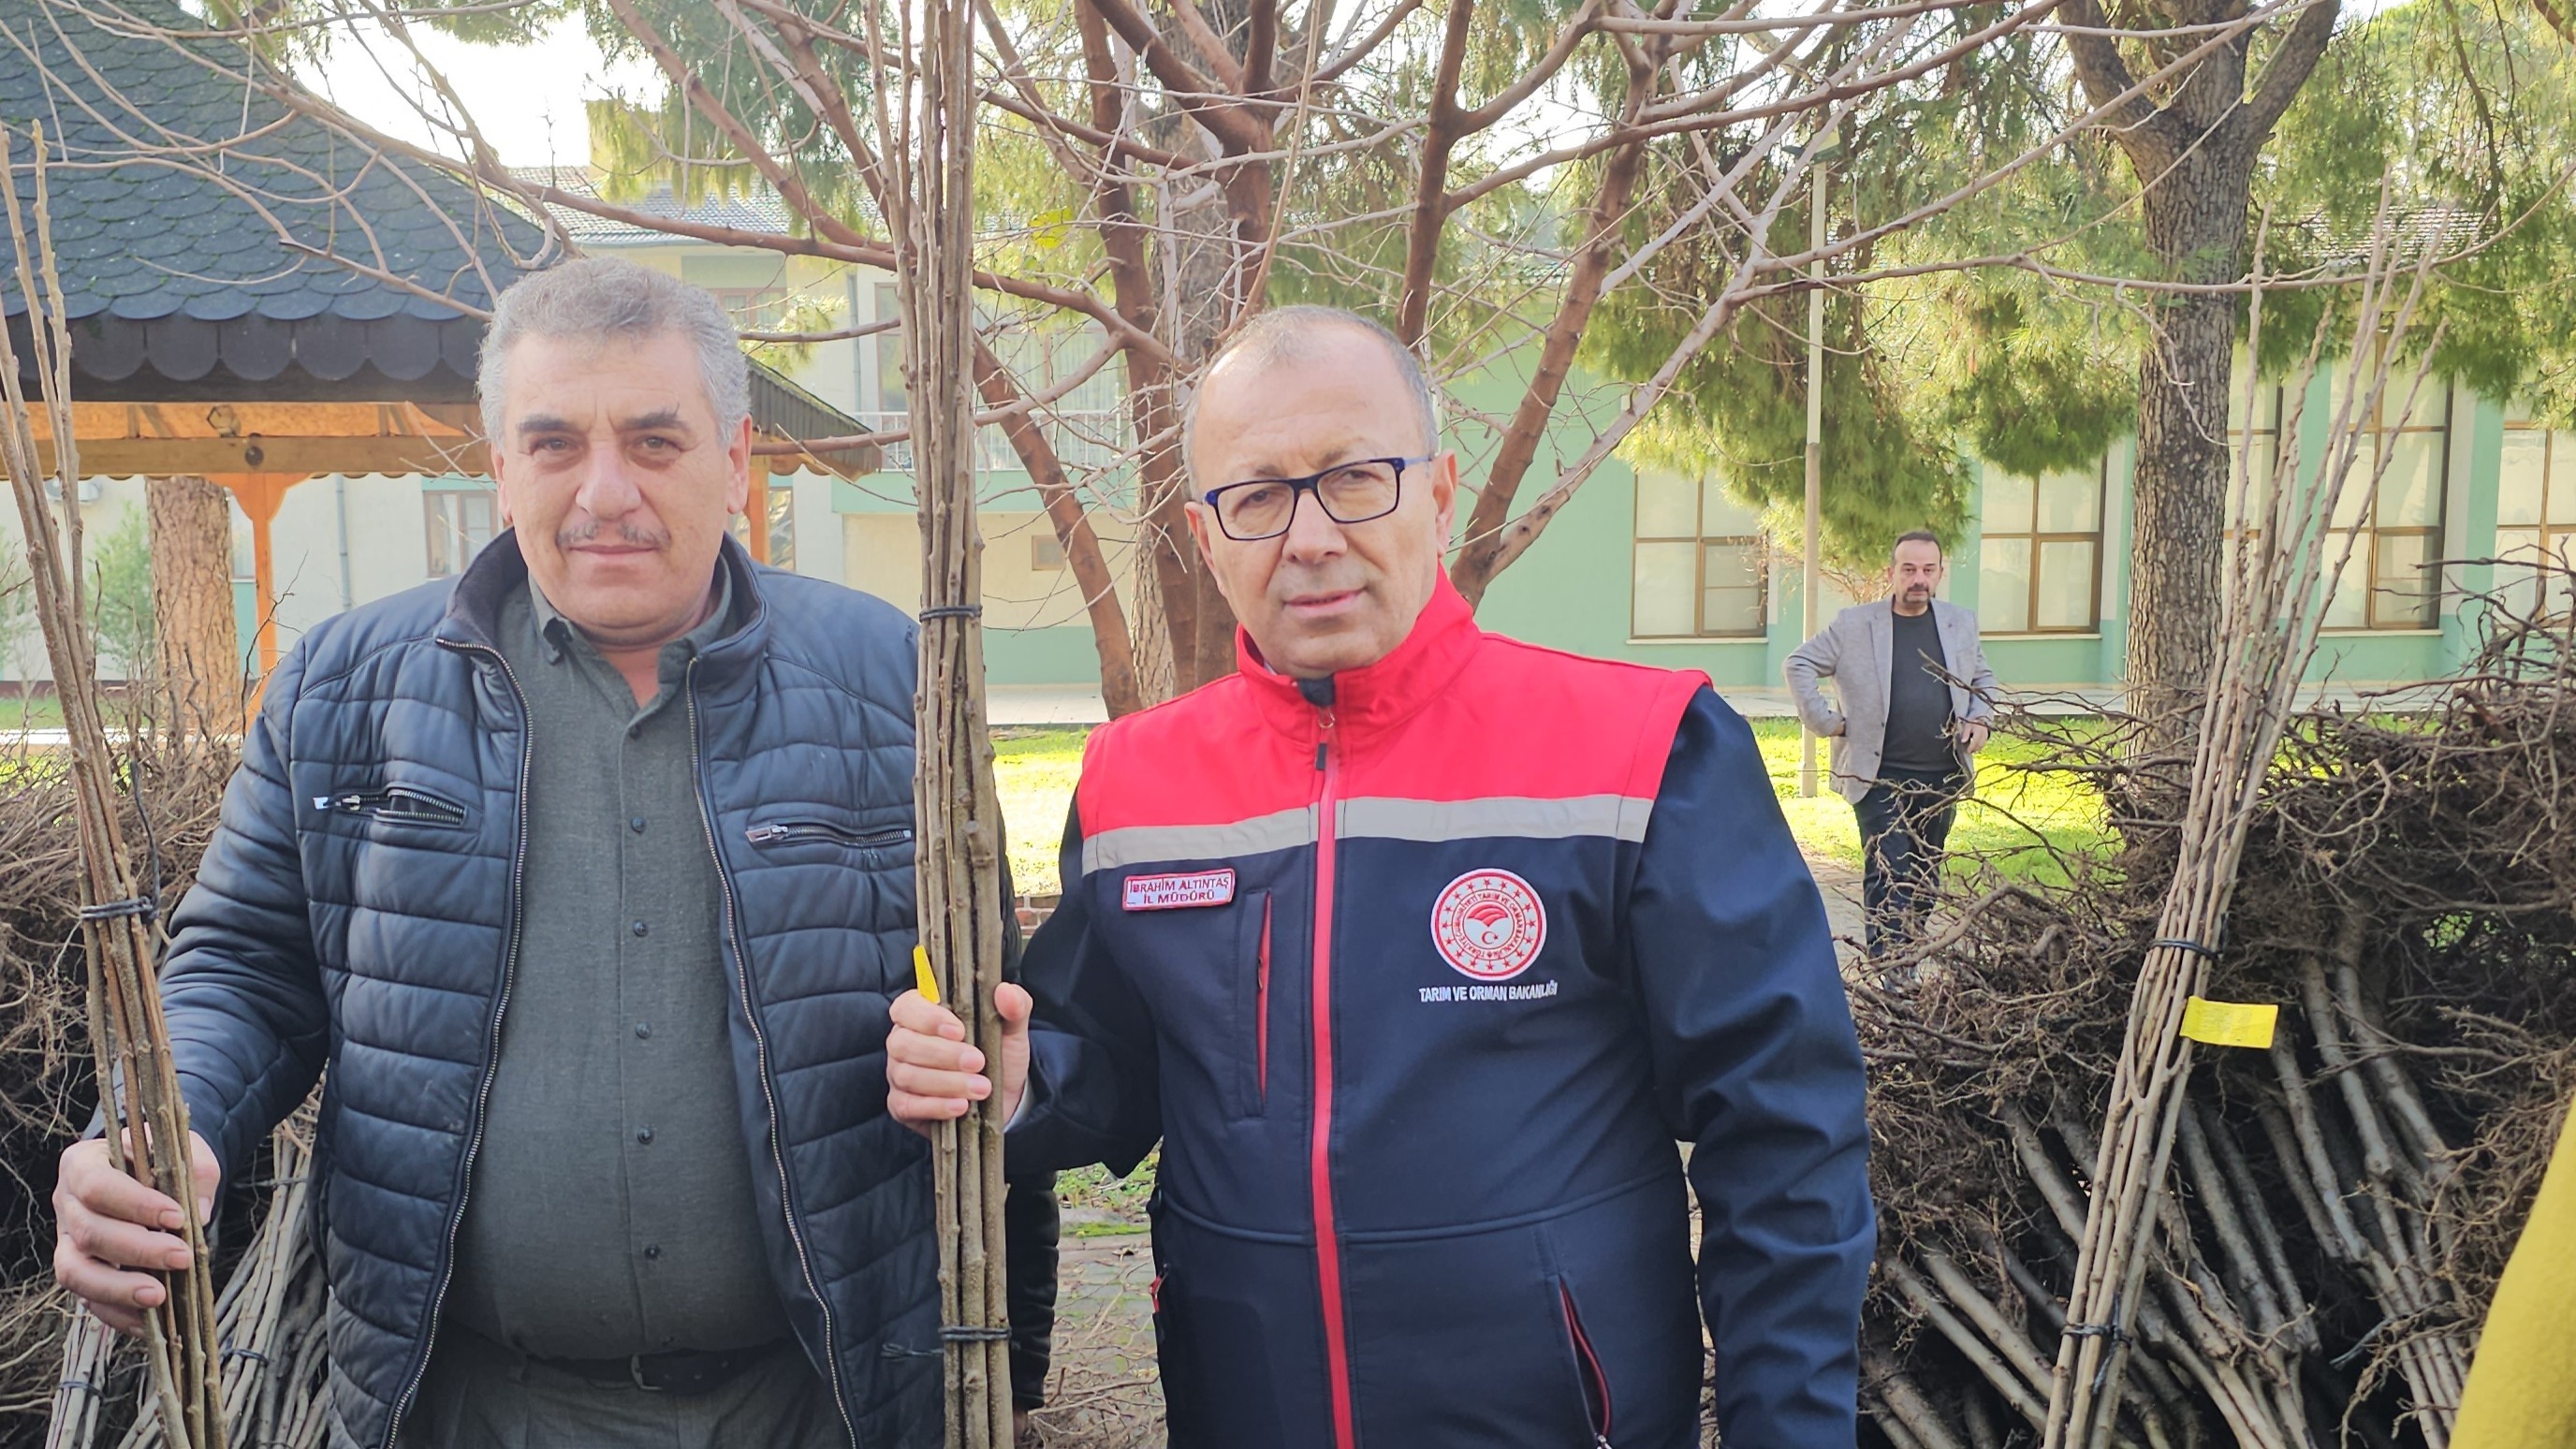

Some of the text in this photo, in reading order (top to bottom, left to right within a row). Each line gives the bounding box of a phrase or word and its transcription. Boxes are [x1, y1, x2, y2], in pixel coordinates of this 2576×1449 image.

[1130, 876, 1229, 893] İBRAHİM ALTINTAŞ
[1144, 889, 1215, 904] İL MÜDÜRÜ
[1418, 979, 1559, 1002] TARIM VE ORMAN BAKANLIĞI
